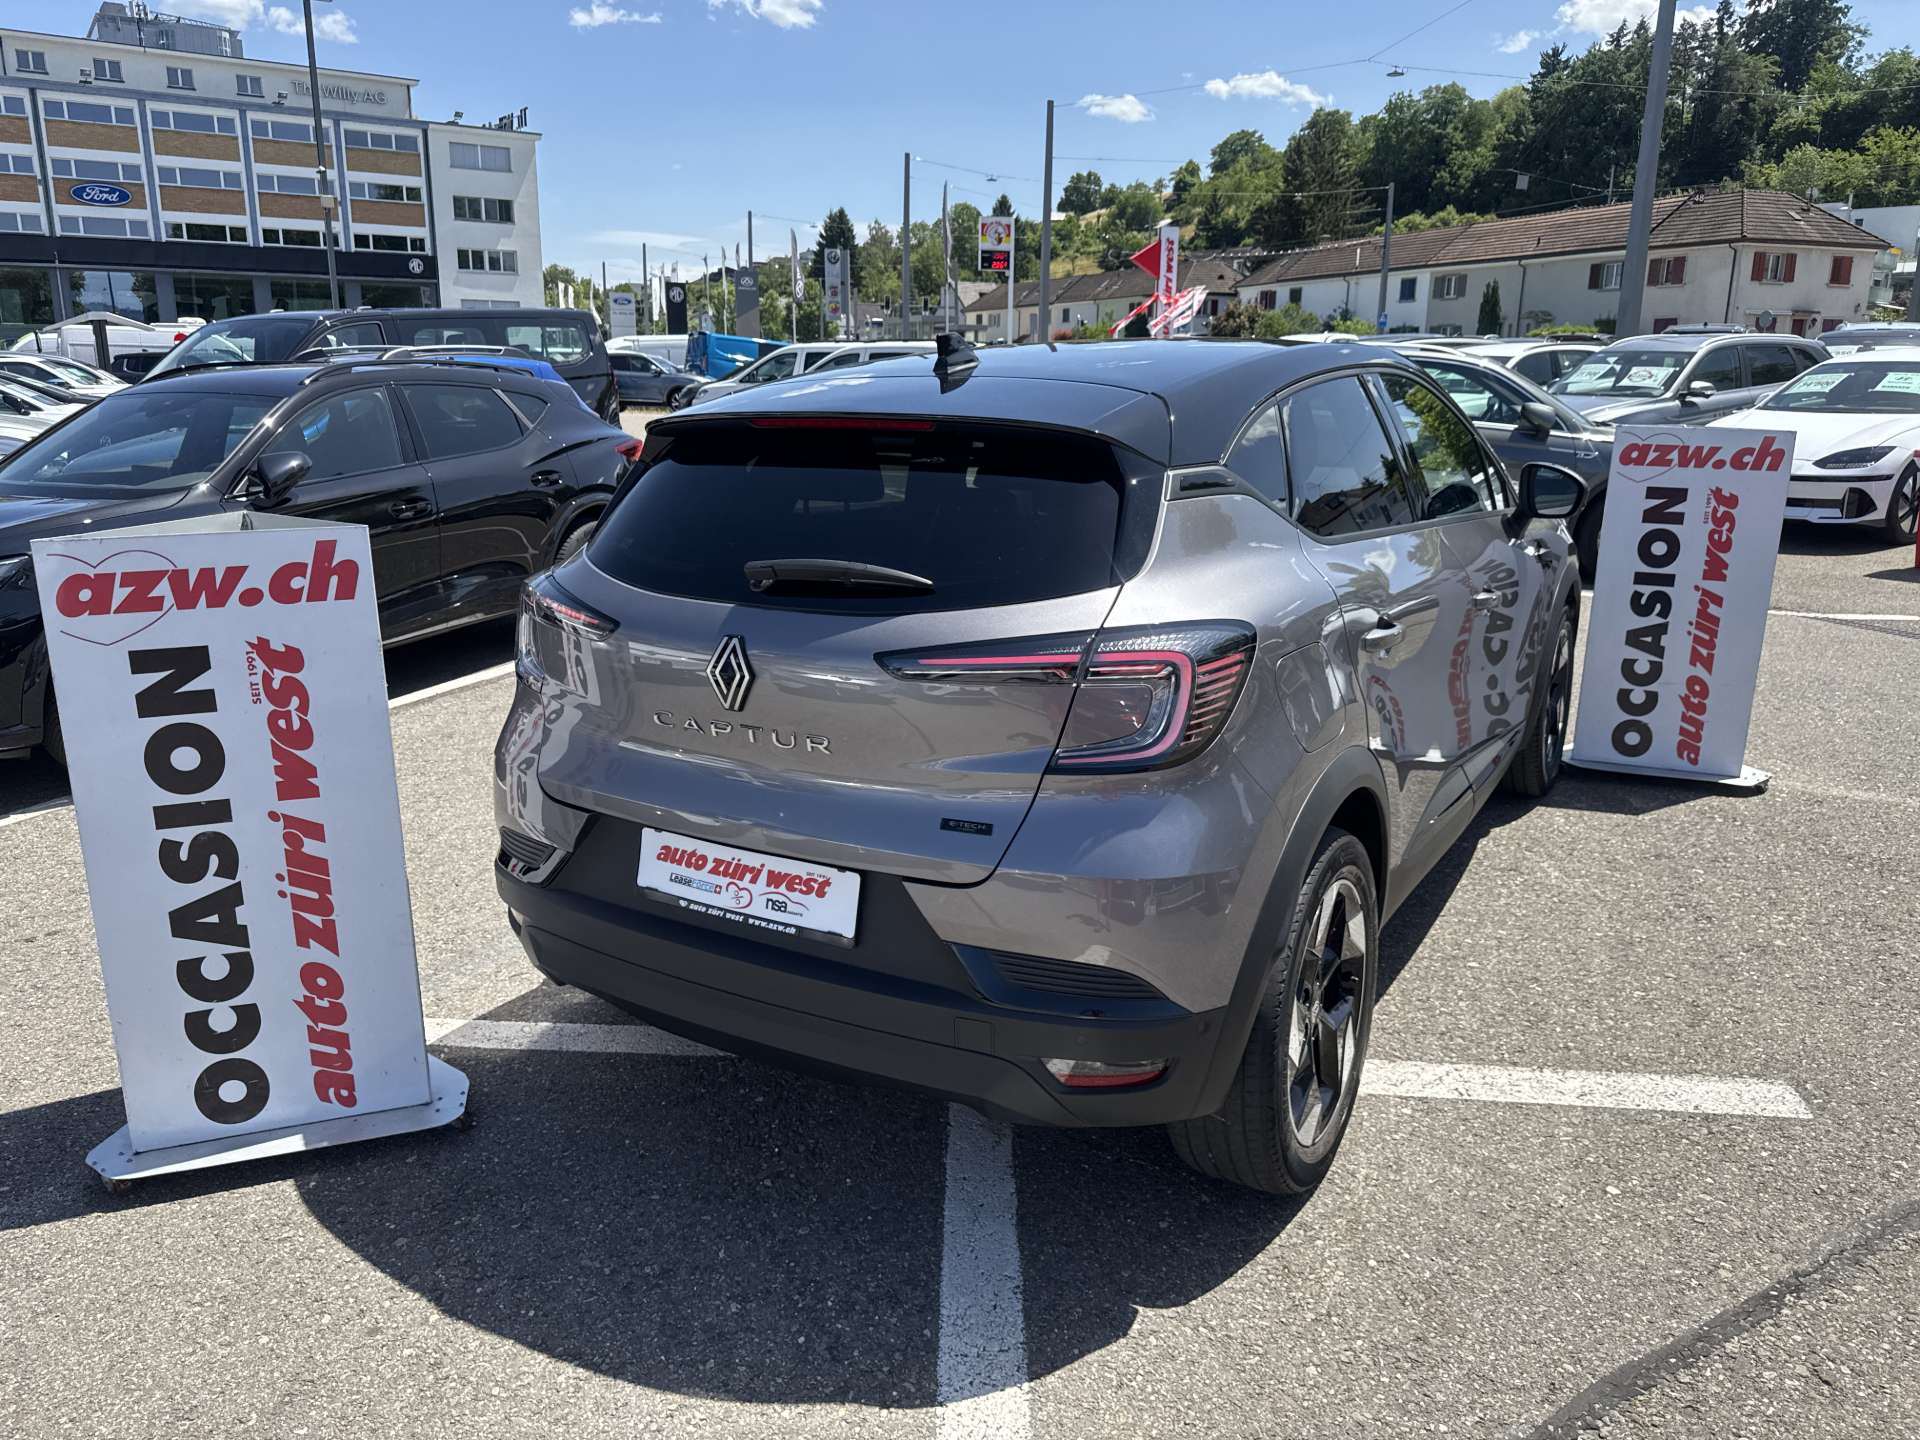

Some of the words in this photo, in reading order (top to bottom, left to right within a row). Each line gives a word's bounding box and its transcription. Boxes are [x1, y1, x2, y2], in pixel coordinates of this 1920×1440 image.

[321, 84, 359, 105] Willy
[362, 89, 386, 105] AG
[82, 186, 120, 202] Ford
[1618, 436, 1786, 472] azw.ch
[1702, 486, 1740, 582] west
[56, 539, 360, 618] azw.ch
[1611, 486, 1689, 758] OCCASION
[1687, 584, 1724, 677] züri
[246, 651, 257, 677] 1991
[250, 682, 262, 704] SEIT
[245, 636, 321, 801] west
[653, 710, 832, 754] CAPTUR
[1676, 675, 1711, 767] auto
[128, 645, 270, 1125] OCCASION
[267, 811, 340, 958] züri
[656, 844, 708, 872] auto
[706, 857, 766, 884] züri
[765, 869, 832, 898] west
[689, 903, 706, 913] auto
[707, 907, 725, 918] züri
[725, 911, 744, 922] west
[748, 917, 797, 935] www.azw.ch
[766, 898, 788, 914] nsa
[292, 962, 358, 1109] auto
